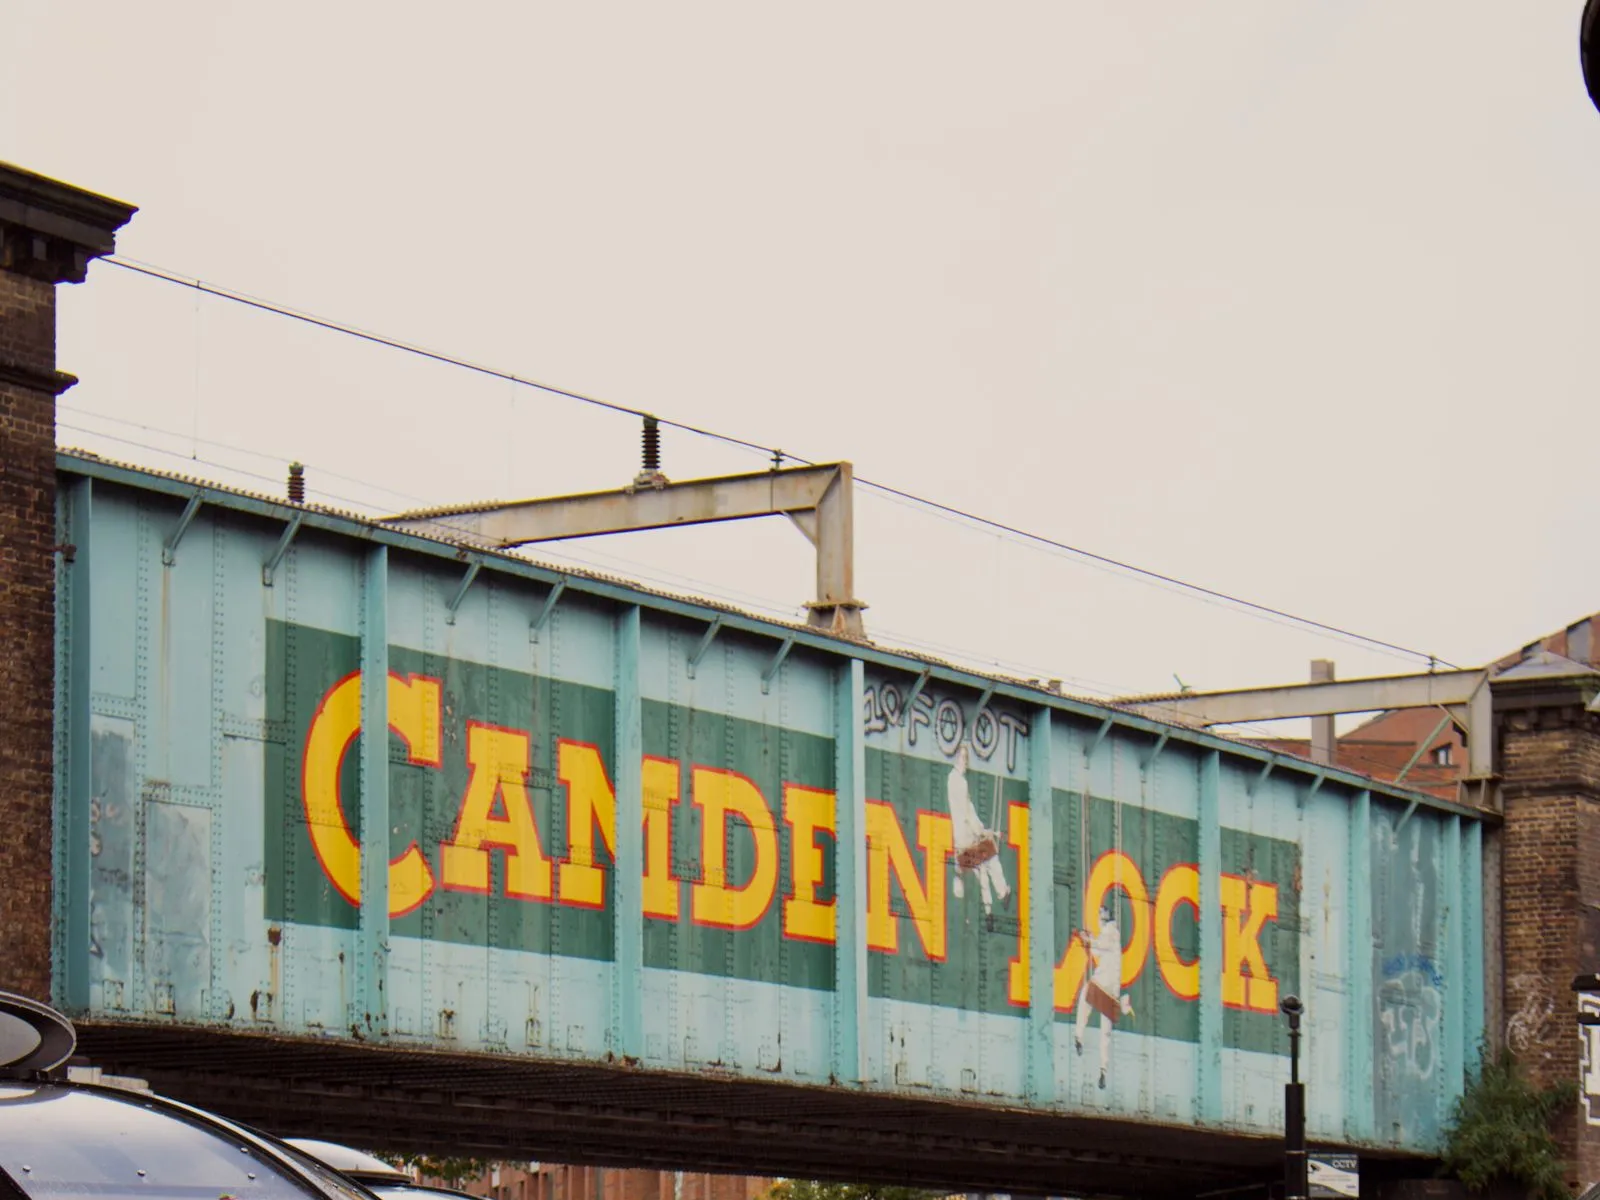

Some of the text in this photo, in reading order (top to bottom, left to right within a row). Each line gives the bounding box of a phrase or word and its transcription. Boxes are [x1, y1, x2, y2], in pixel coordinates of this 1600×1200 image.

[303, 669, 1280, 1015] CAMDEN LOCK
[1333, 1159, 1357, 1169] CCTV
